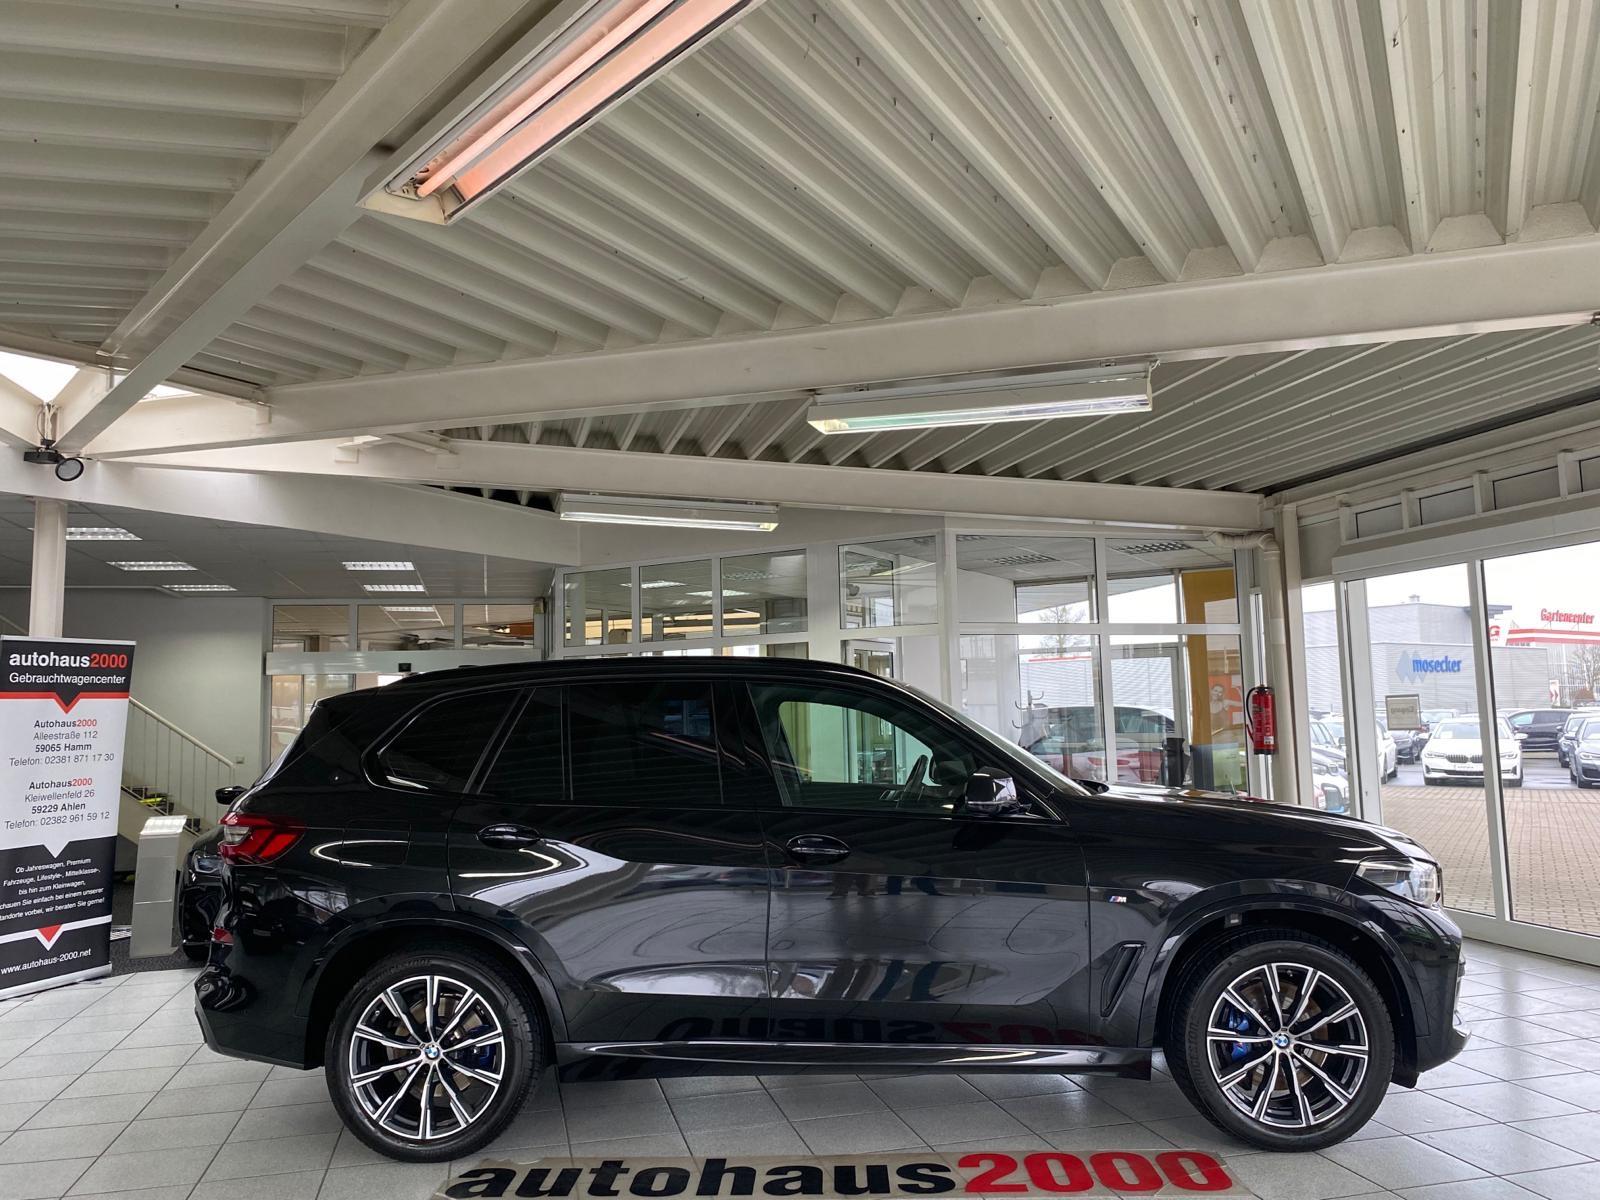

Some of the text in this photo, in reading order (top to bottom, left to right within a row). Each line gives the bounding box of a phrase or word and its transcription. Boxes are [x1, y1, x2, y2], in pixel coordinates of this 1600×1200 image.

[1540, 608, 1595, 624] Gartencenter
[9, 652, 128, 668] autohaus2000
[1412, 655, 1462, 673] mosecker
[9, 672, 126, 686] Gebrauchtwagencenter
[34, 719, 97, 729] Autohaus2000
[33, 731, 98, 741] Alleestraße 112
[35, 743, 92, 753] 59065 Hamm
[8, 752, 115, 767] Telefon: 02381 871 17 30
[29, 778, 93, 790] Autohaus2000
[24, 789, 95, 803] Kleiwellenfeld 26
[31, 802, 86, 814] 59229 Ahlen
[5, 811, 110, 830] Telefon: 02382 961 59 12
[25, 862, 65, 873] Jahreswagen,
[66, 858, 92, 866] Premium
[3, 877, 35, 887] Fahrzeuge,
[33, 895, 55, 904] einfach
[65, 891, 82, 899] einem
[83, 887, 104, 896] unserer
[55, 902, 77, 911] beraten
[0, 948, 91, 975] www.autohaus-2000.net
[445, 1151, 1233, 1199] autohaus2000
